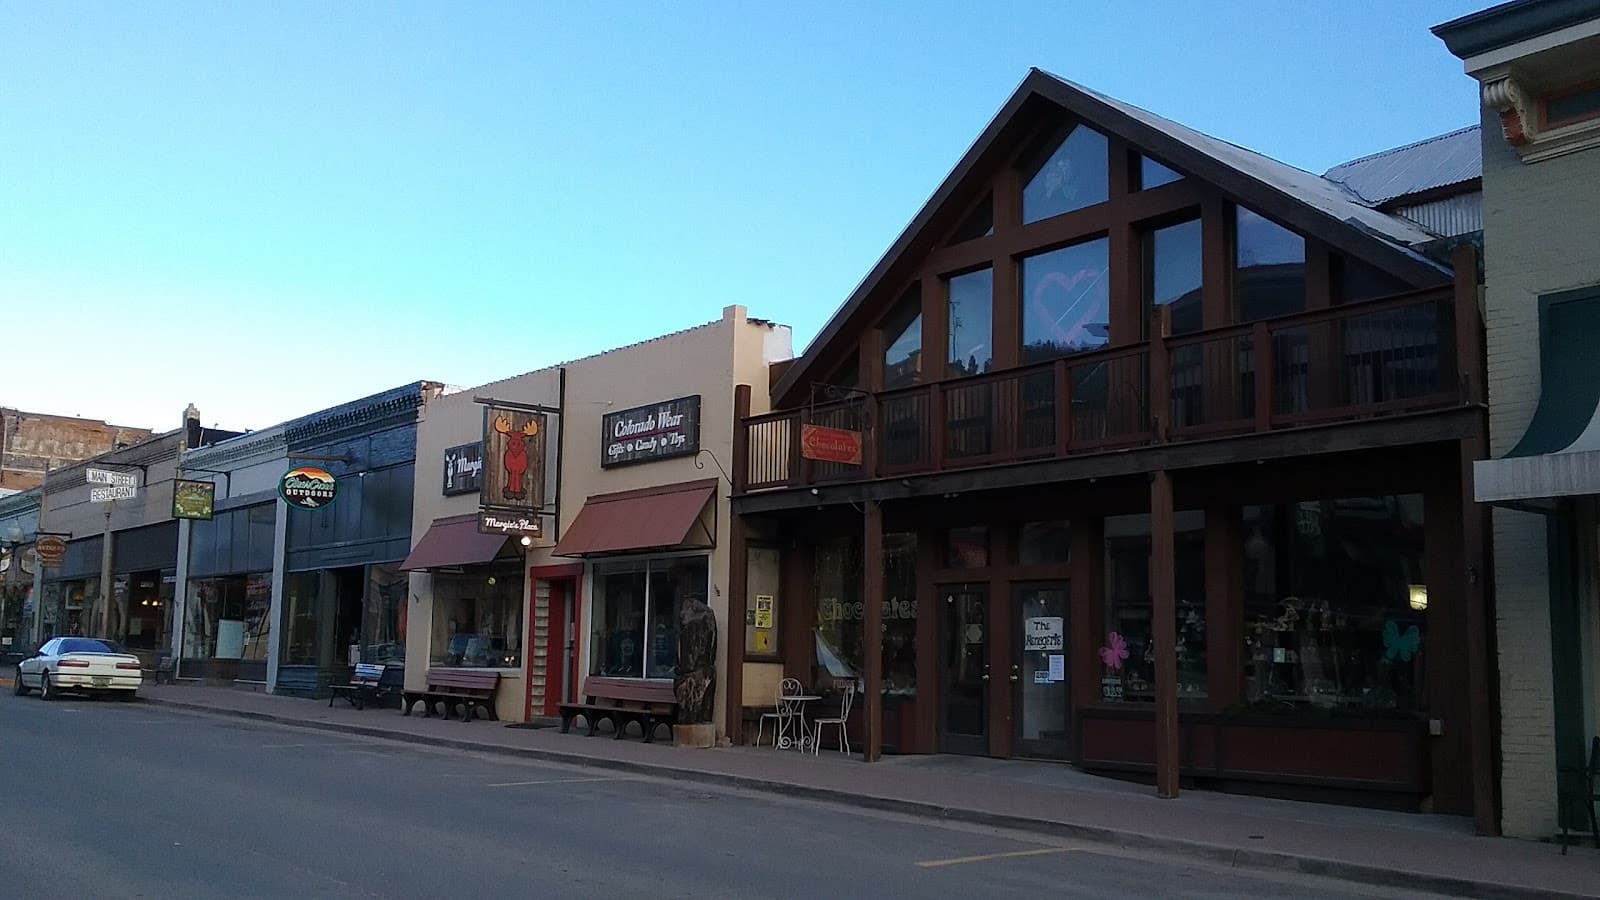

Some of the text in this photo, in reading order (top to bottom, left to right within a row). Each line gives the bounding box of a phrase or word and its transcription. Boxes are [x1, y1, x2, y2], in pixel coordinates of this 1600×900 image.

[614, 410, 684, 438] Colorado Wear
[608, 431, 686, 458] Gifts Candy Toys
[808, 434, 857, 453] Chocolates
[91, 471, 131, 485] MAIN STREET
[92, 487, 134, 501] RESTAURANT
[286, 489, 334, 498] OUTDOORS
[485, 517, 539, 532] Margie's Place
[823, 596, 918, 621] Chocates
[1033, 621, 1051, 631] The
